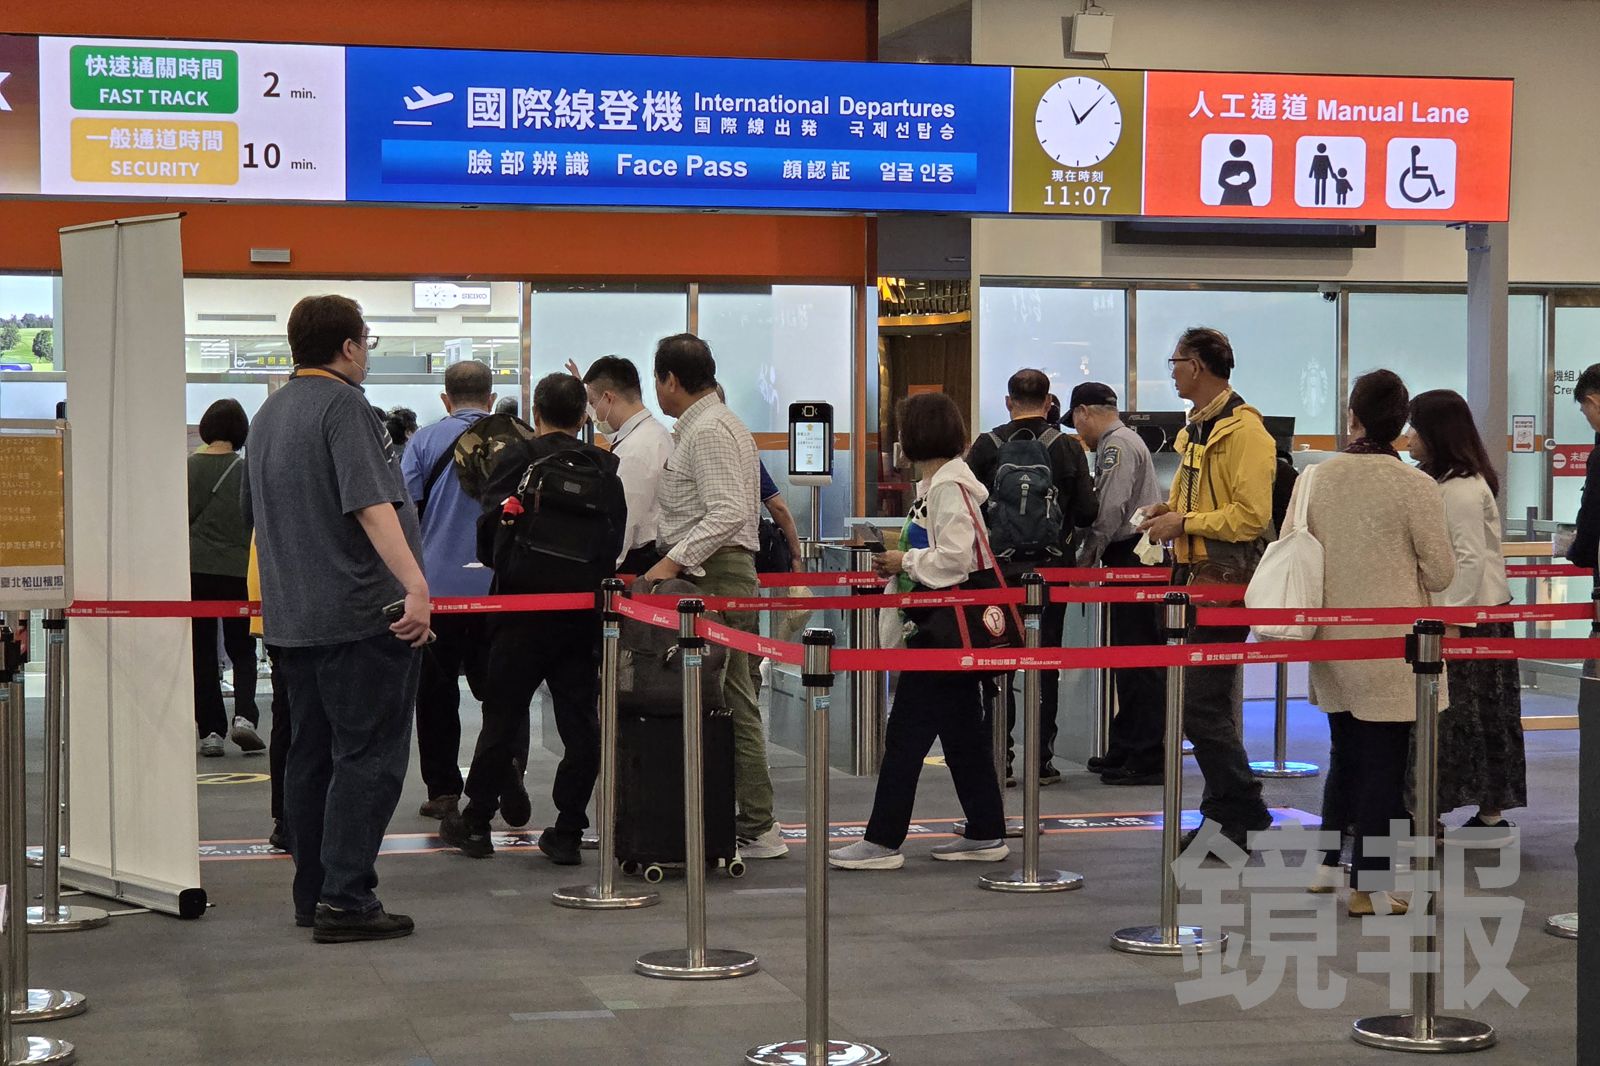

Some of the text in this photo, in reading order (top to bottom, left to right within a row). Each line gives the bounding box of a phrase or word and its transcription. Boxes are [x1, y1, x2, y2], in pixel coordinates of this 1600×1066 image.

[85, 54, 223, 81] 快速通關時間
[100, 88, 209, 107] FAST TRACK
[263, 72, 316, 99] 2 min.
[466, 87, 683, 133] 國際線登機
[694, 92, 955, 119] International Departures
[1189, 91, 1470, 123] 人工通道 Manual Lane
[694, 116, 818, 136] 国際線出発
[86, 127, 223, 152] 一般通道時間
[111, 161, 200, 177] SECURITY
[243, 143, 317, 171] 10 min.
[467, 150, 590, 177] 臉部辨識
[617, 153, 748, 178] Face Pass
[880, 162, 955, 183] 얼굴 인증
[1051, 169, 1104, 183] 現在時刻
[1043, 185, 1112, 206] 11:07
